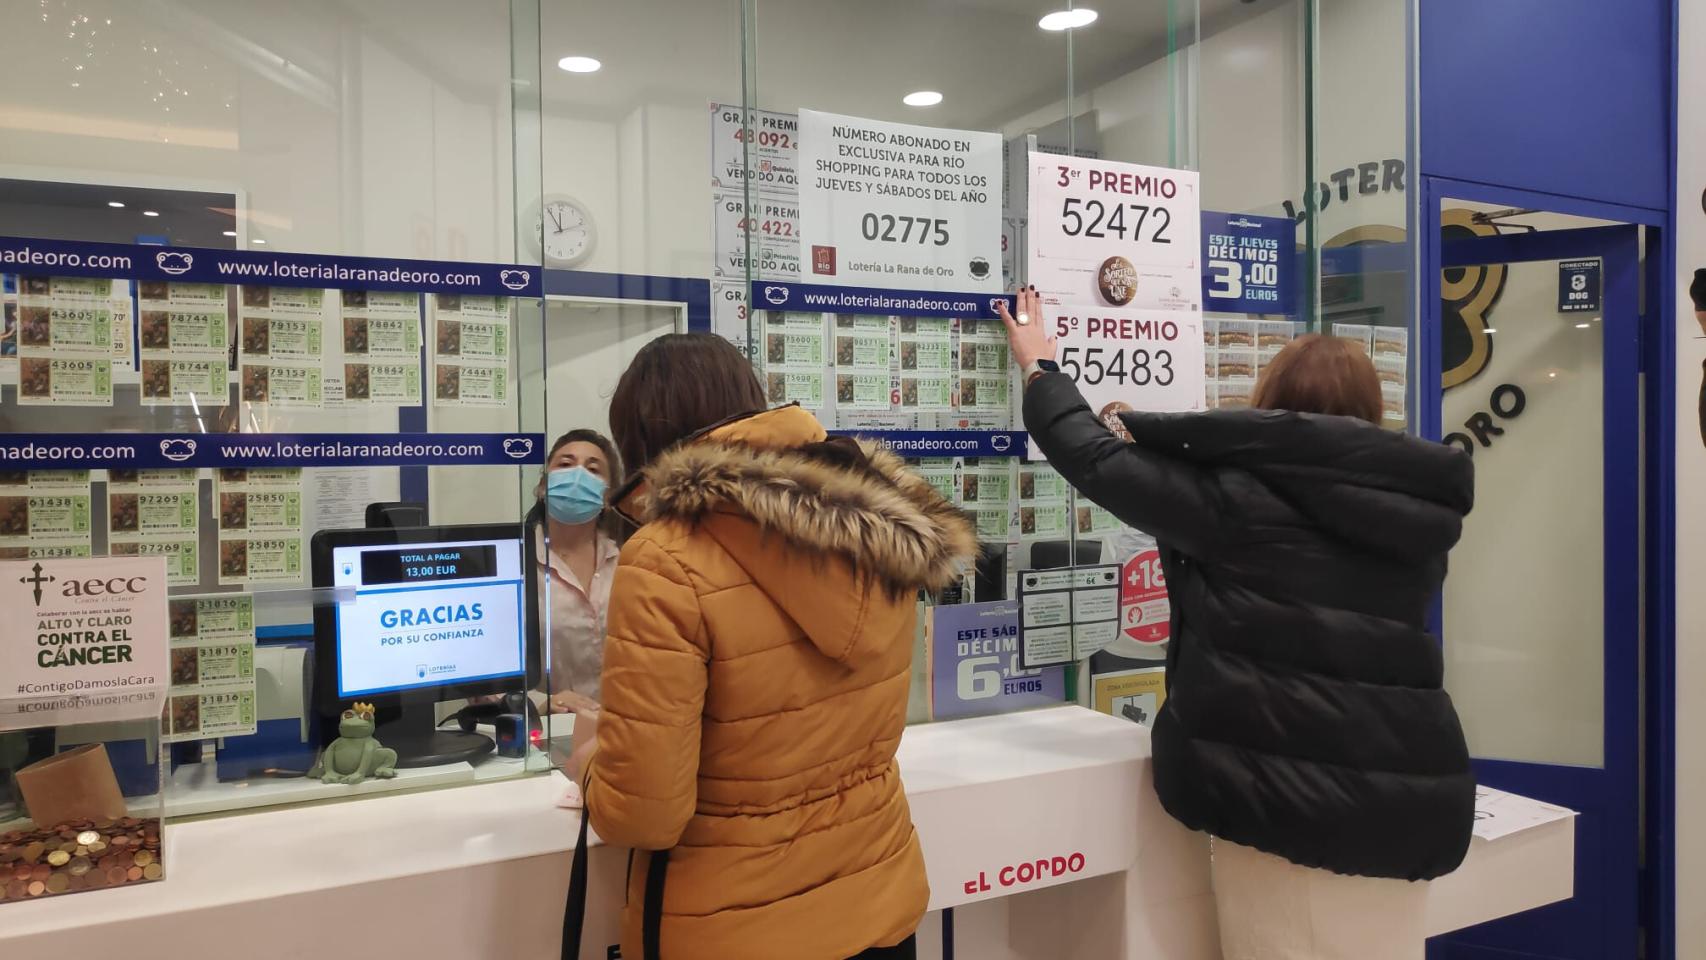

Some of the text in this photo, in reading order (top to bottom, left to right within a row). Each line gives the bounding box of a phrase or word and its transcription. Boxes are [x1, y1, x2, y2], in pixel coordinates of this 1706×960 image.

[763, 118, 798, 131] PREMI
[832, 125, 970, 152] NÚMERO ABONADO EN
[838, 144, 964, 168] EXCLUSIVA PARA RÍO
[816, 160, 986, 187] SHOPPING PARA TODOS LOS
[816, 177, 987, 203] JUEVES Y SÁBADOS DEL AÑO
[1089, 170, 1176, 199] PREMIO
[1282, 159, 1404, 226] LOTER
[766, 206, 800, 219] PREMI
[1062, 198, 1171, 244] 52472
[862, 213, 950, 246] 02775
[1209, 234, 1278, 249] ESTE JUEVES
[0, 247, 132, 269] adeoro.com
[1209, 243, 1278, 262] DÉCIMOS
[218, 260, 481, 286] www.loterialaranadeoro.com
[849, 262, 954, 277] Lotería La Rana de Oro
[1208, 260, 1278, 298] 3,00
[804, 293, 976, 311] www.loterialaranadeoro.com
[1246, 289, 1278, 301] EUROS
[52, 310, 93, 320] 43605
[170, 313, 208, 323] 78744
[271, 321, 306, 331] 79153
[369, 321, 402, 329] 78842
[462, 325, 493, 334] 74441
[1057, 316, 1178, 341] 5º PREMIO
[52, 361, 93, 370] 43605
[172, 362, 209, 371] 78744
[271, 368, 306, 377] 79153
[370, 366, 404, 375] 78842
[461, 368, 492, 377] 74441
[1062, 348, 1174, 386] 55483
[221, 442, 483, 457] www.loterialaranadeoro.com
[880, 438, 978, 450] laranadeoro.com
[30, 498, 72, 507] 61438
[140, 496, 179, 504] 97269
[248, 541, 285, 549] 25850
[400, 555, 425, 563] TOTAL
[434, 553, 461, 561] PAGAR
[406, 566, 456, 577] 13,00 EUR
[1128, 558, 1166, 589] +18
[62, 576, 147, 596] aecc
[199, 600, 236, 609] 31816
[38, 615, 132, 630] ALTO Y CLARO
[380, 603, 483, 628] GRACIAS
[38, 630, 132, 646] CONTRA EL
[381, 628, 484, 646] POR SU CONFIANZA
[958, 624, 1016, 640] ESTE SÁB
[200, 648, 237, 657] 31816
[958, 638, 1016, 656] DÉCIM
[38, 644, 132, 668] CÁNCER
[18, 675, 155, 694] #ContigoDamoslaCara
[1004, 680, 1042, 695] EUROS
[201, 695, 238, 704] 31816
